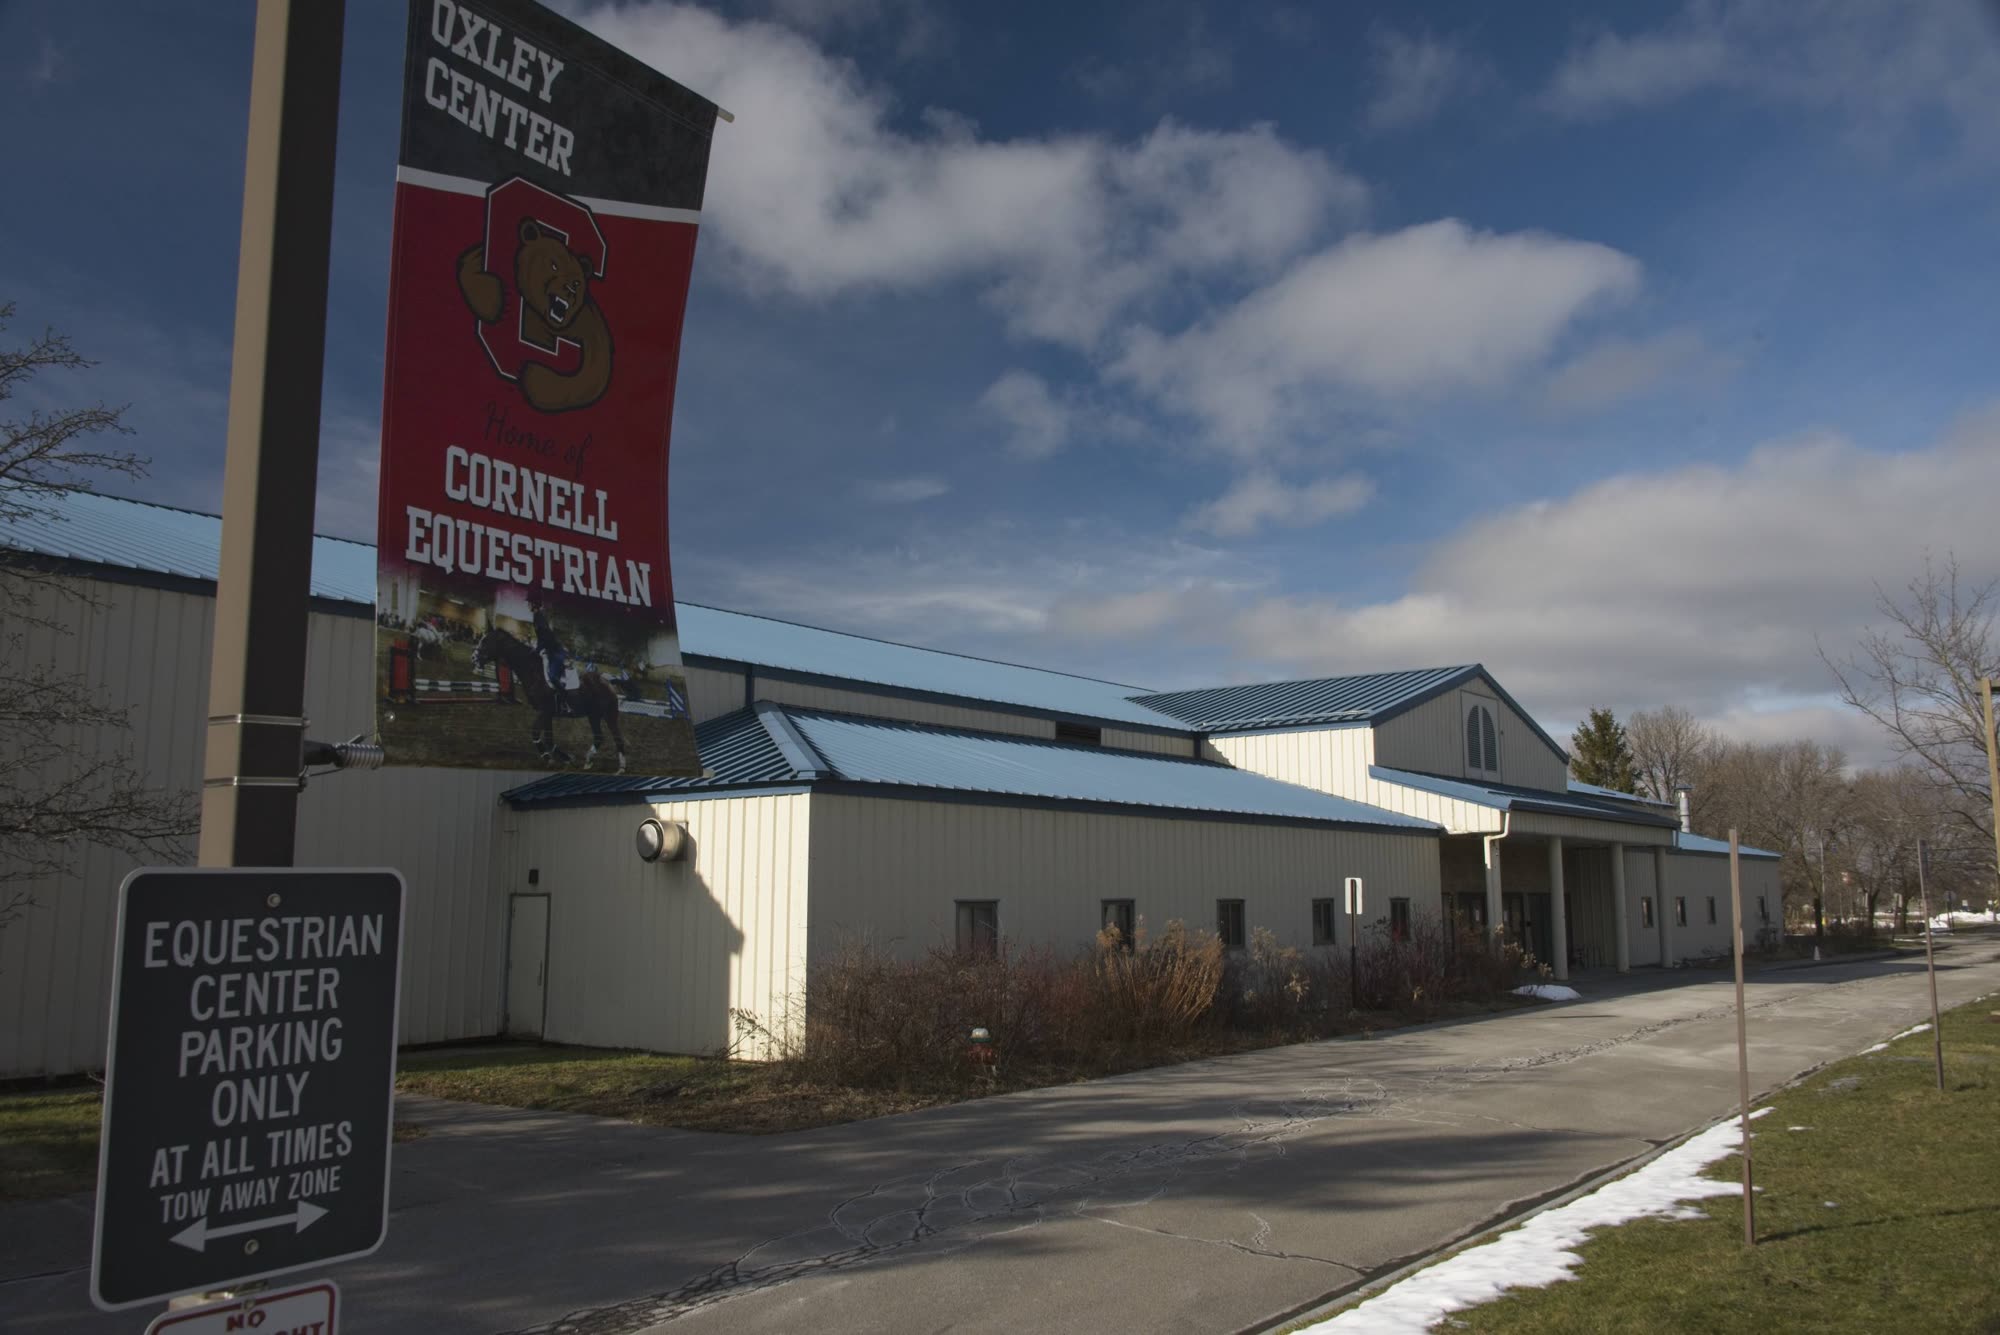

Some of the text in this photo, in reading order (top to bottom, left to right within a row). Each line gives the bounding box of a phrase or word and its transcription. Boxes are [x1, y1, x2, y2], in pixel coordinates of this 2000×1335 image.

[431, 0, 564, 103] OXLEY
[425, 57, 575, 176] CENTER
[483, 401, 593, 477] Home of
[445, 445, 618, 541] CORNELL
[405, 505, 652, 607] EQUESTRIAN
[144, 914, 384, 968] EQUESTRIAN
[190, 967, 340, 1022] CENTER
[178, 1017, 343, 1078] PARKING
[211, 1071, 311, 1127] ONLY
[149, 1120, 353, 1189] AT ALL TIMES
[160, 1165, 341, 1224] TOW AWAY ZONE
[226, 1310, 267, 1332] NO
